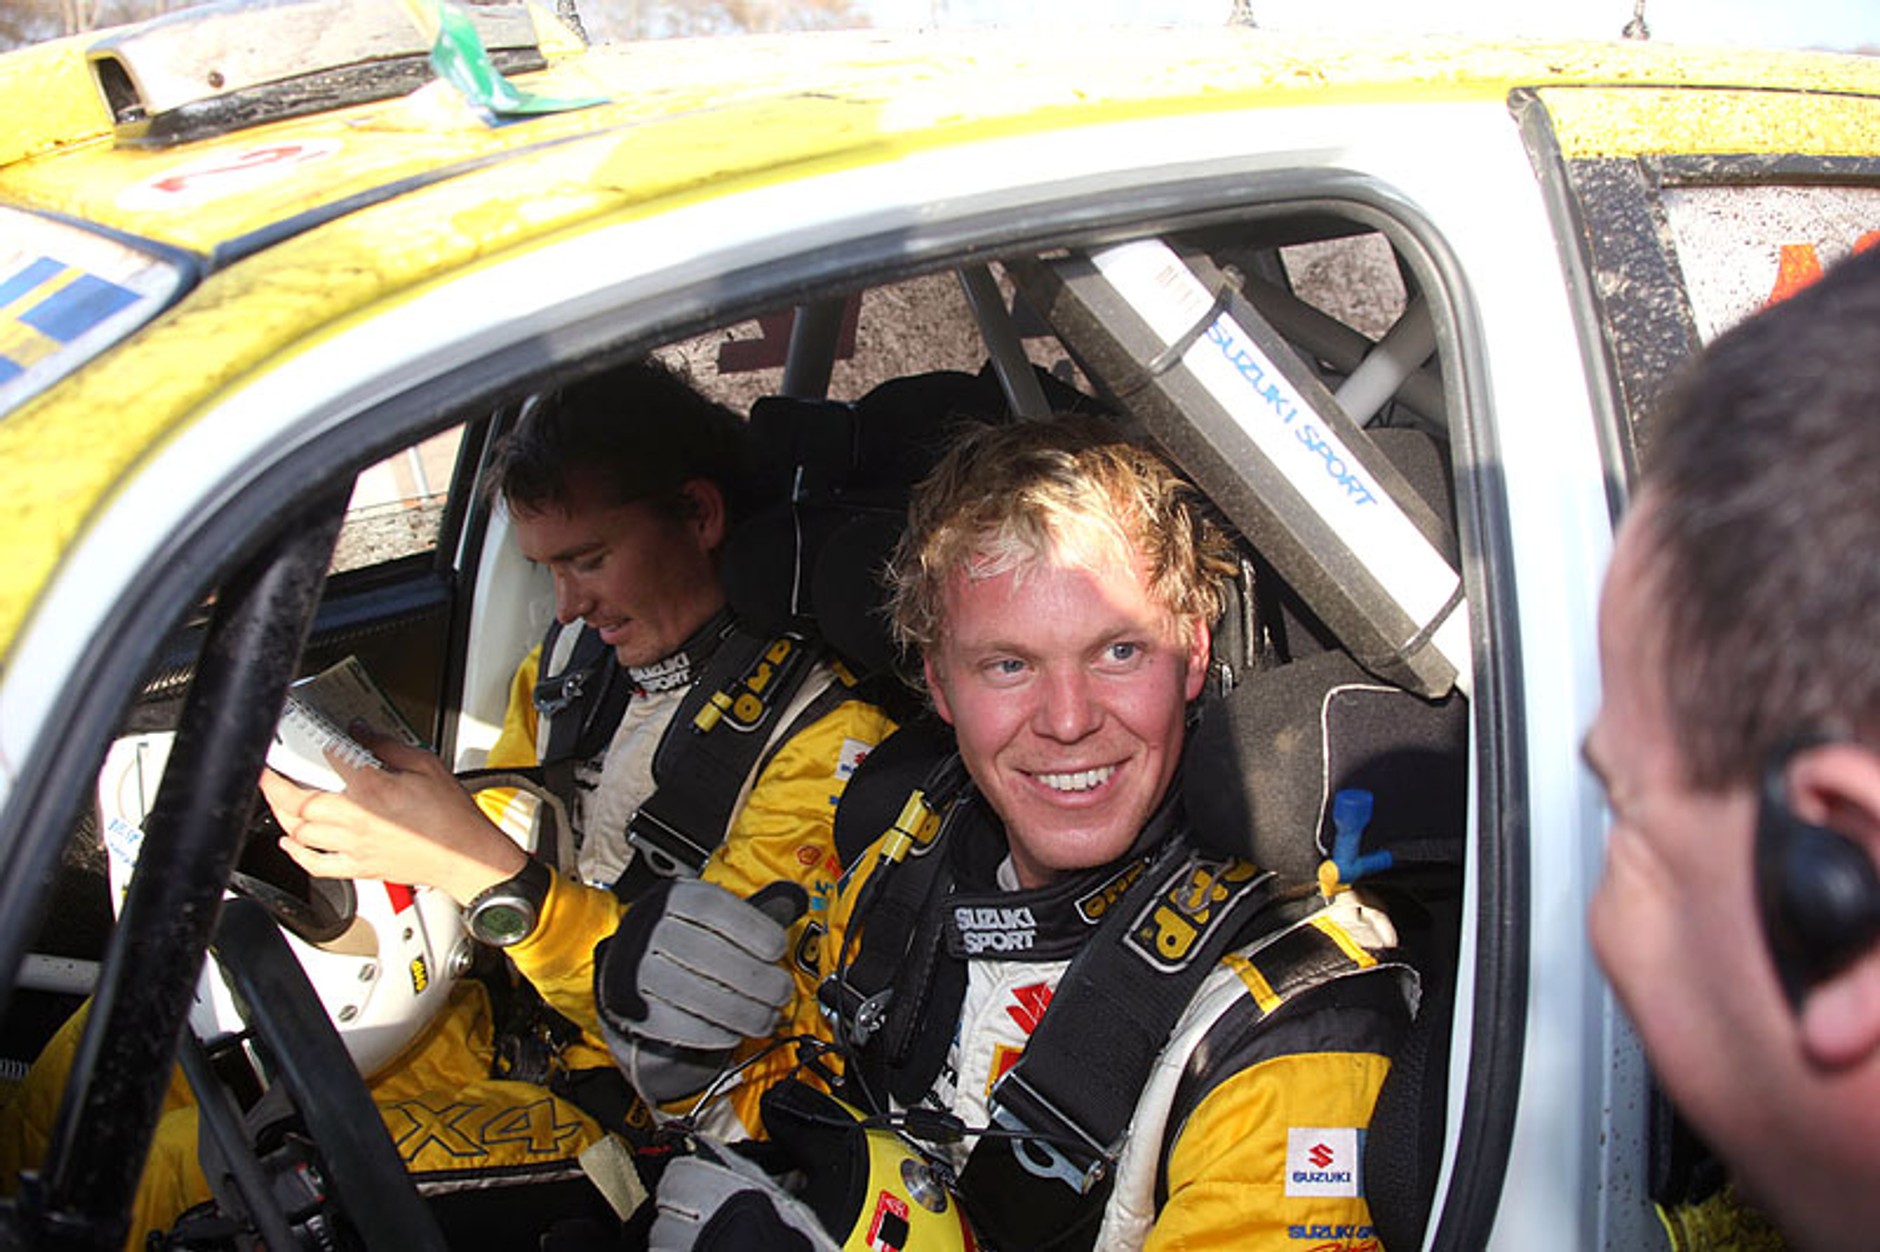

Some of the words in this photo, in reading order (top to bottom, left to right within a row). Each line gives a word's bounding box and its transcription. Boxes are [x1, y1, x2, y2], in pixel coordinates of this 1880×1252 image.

[1205, 319, 1298, 424] SUZUKI
[1295, 424, 1379, 506] SPORT
[954, 906, 1038, 930] SUZUKI
[962, 929, 1037, 954] SPORT
[1292, 1171, 1351, 1183] SUZUKI
